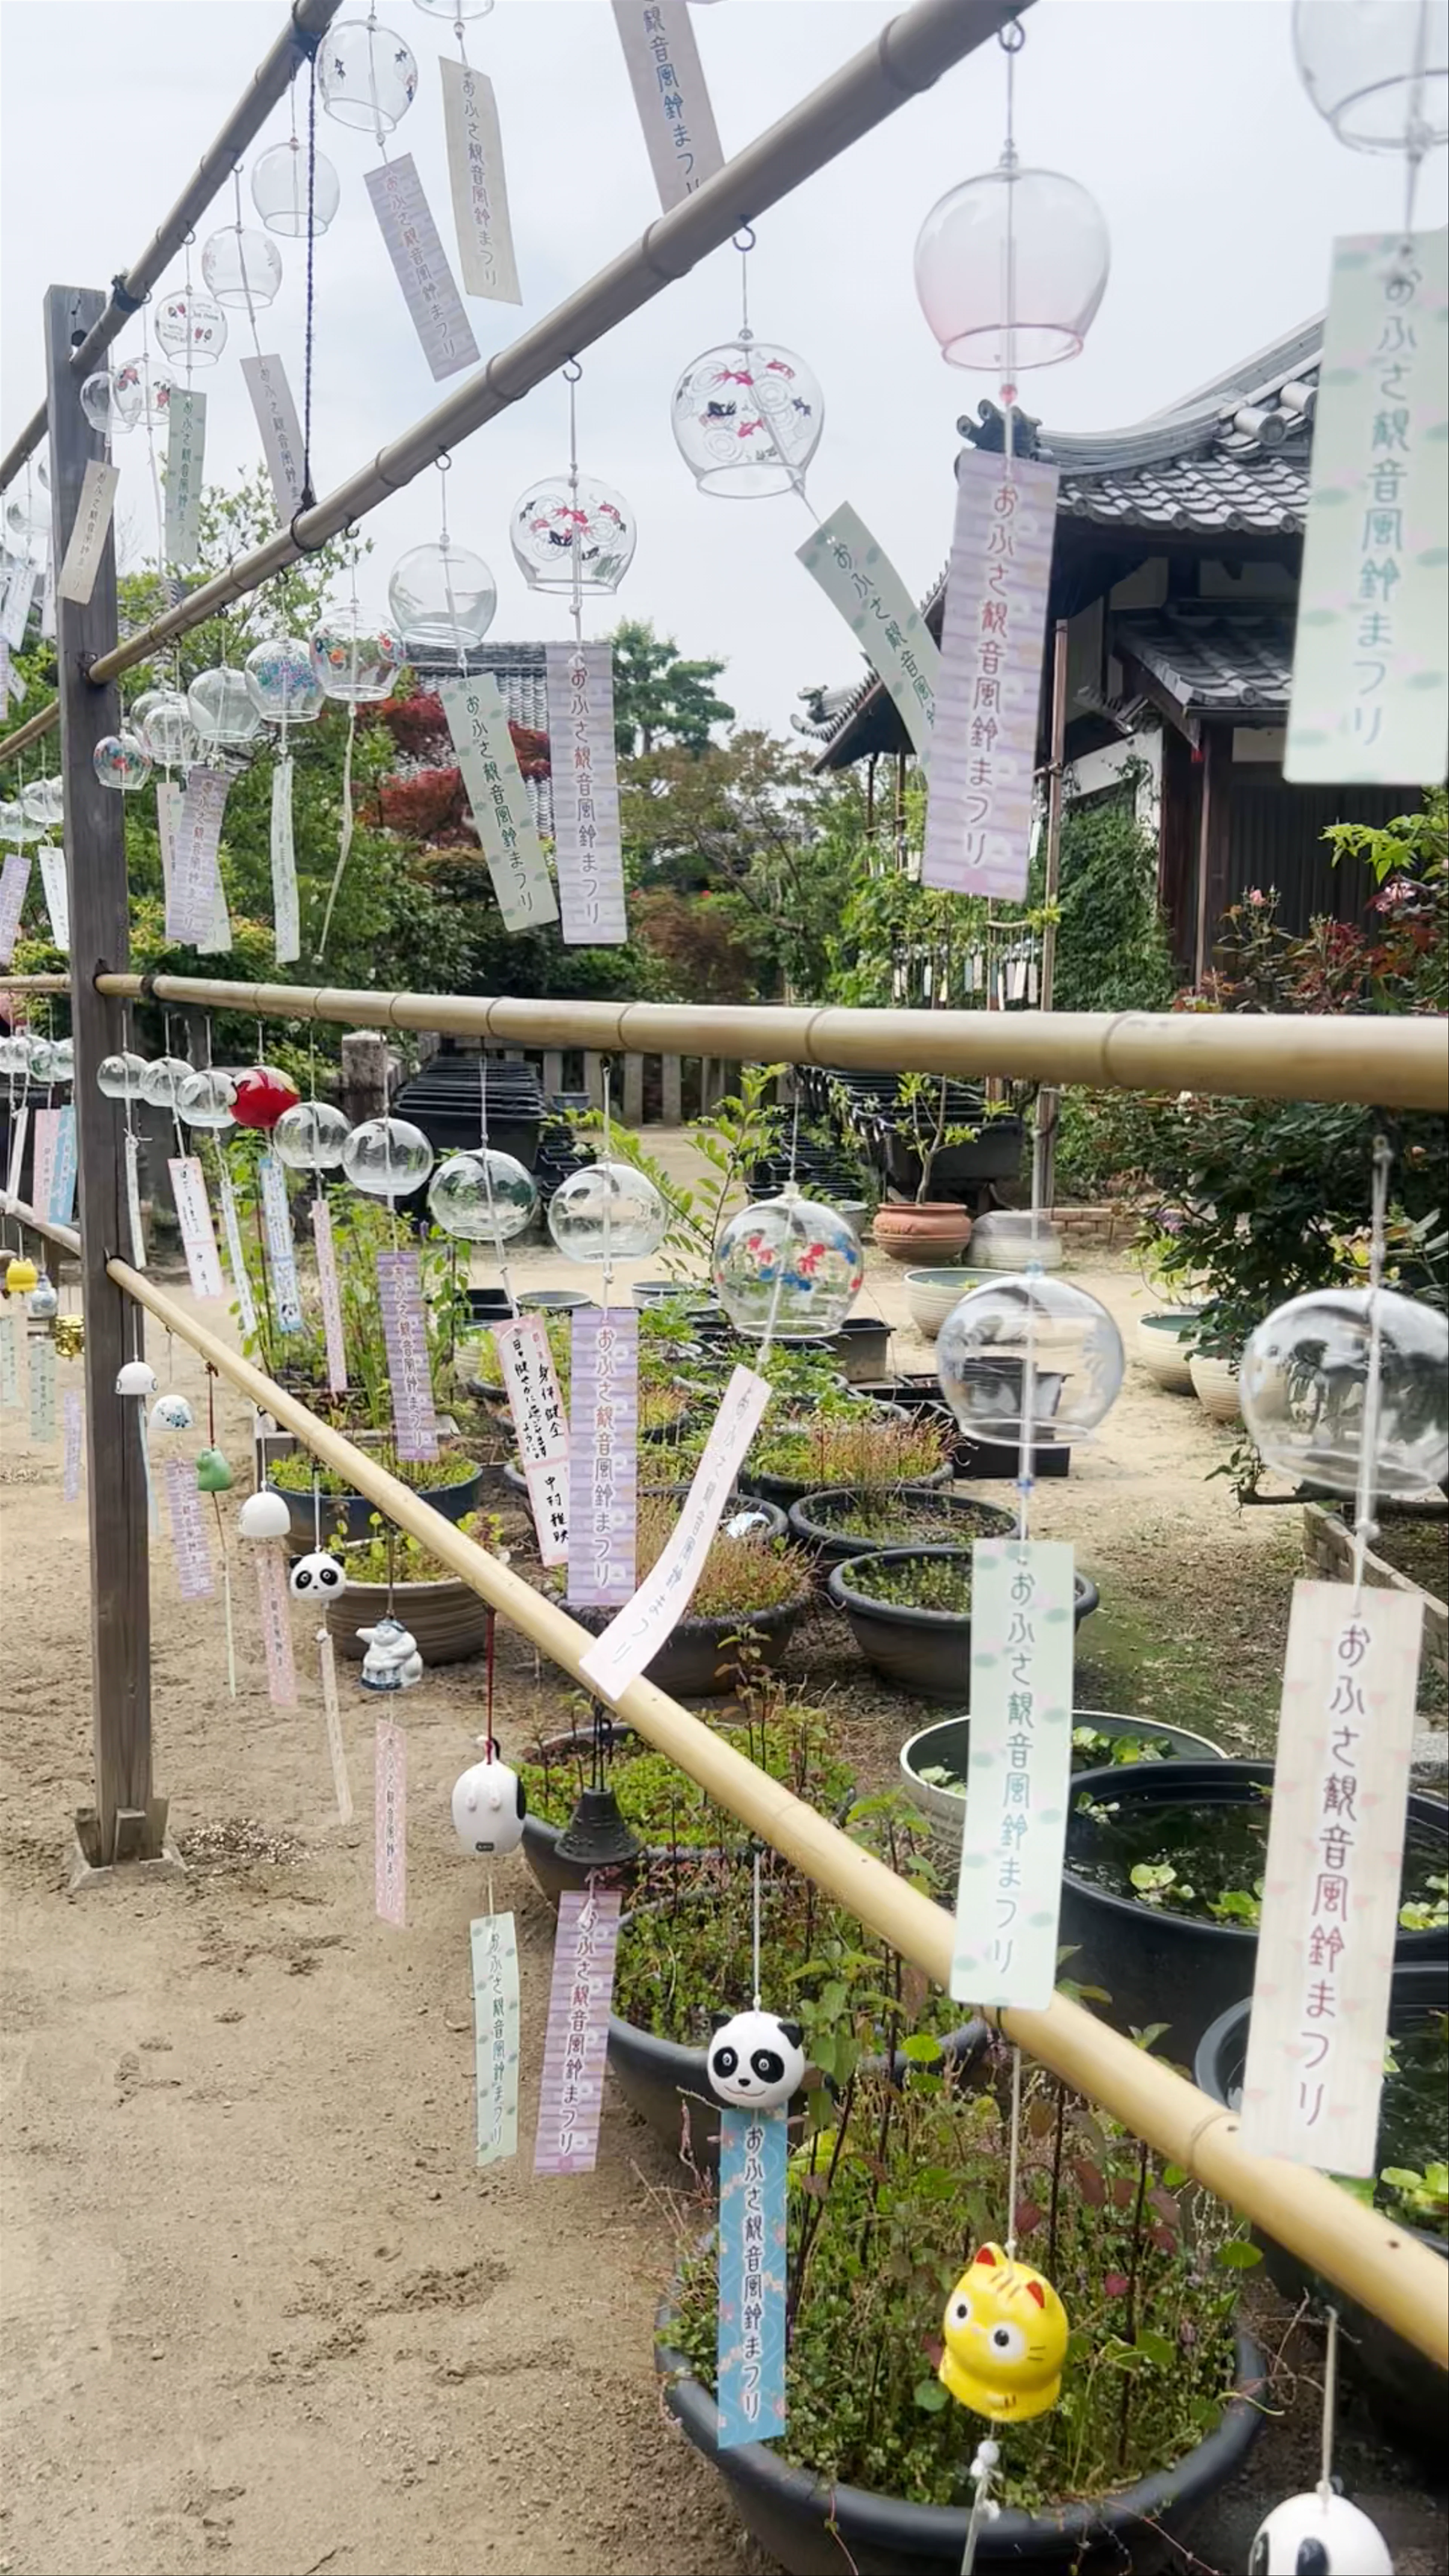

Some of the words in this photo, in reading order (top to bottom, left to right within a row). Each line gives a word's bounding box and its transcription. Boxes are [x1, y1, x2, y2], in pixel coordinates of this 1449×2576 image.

[463, 80, 496, 286] おふさ観音風鈴まつり
[643, 0, 699, 194] 観音風鈴まつ
[386, 176, 455, 359] おふさ観音風鈴まつり
[260, 368, 301, 506] おふさ観音風鈴ま
[1354, 269, 1422, 745] おふさ観音風鈴まつり
[571, 668, 599, 924] おふさ観音風鈴まつり
[964, 486, 1018, 865] おふさ観音風鈴まつり
[466, 696, 533, 912] おふさ観音風鈴まつり
[594, 1330, 614, 1587] おふさ観音風鈴まつり
[993, 1573, 1035, 1972] おふさ観音風鈴まつり
[1300, 1626, 1371, 2125] おふさ観音風鈴まつり
[491, 1933, 505, 2144] おふさ観音風鈴まつり
[745, 2128, 763, 2419] おふさ観音風鈴まつり
